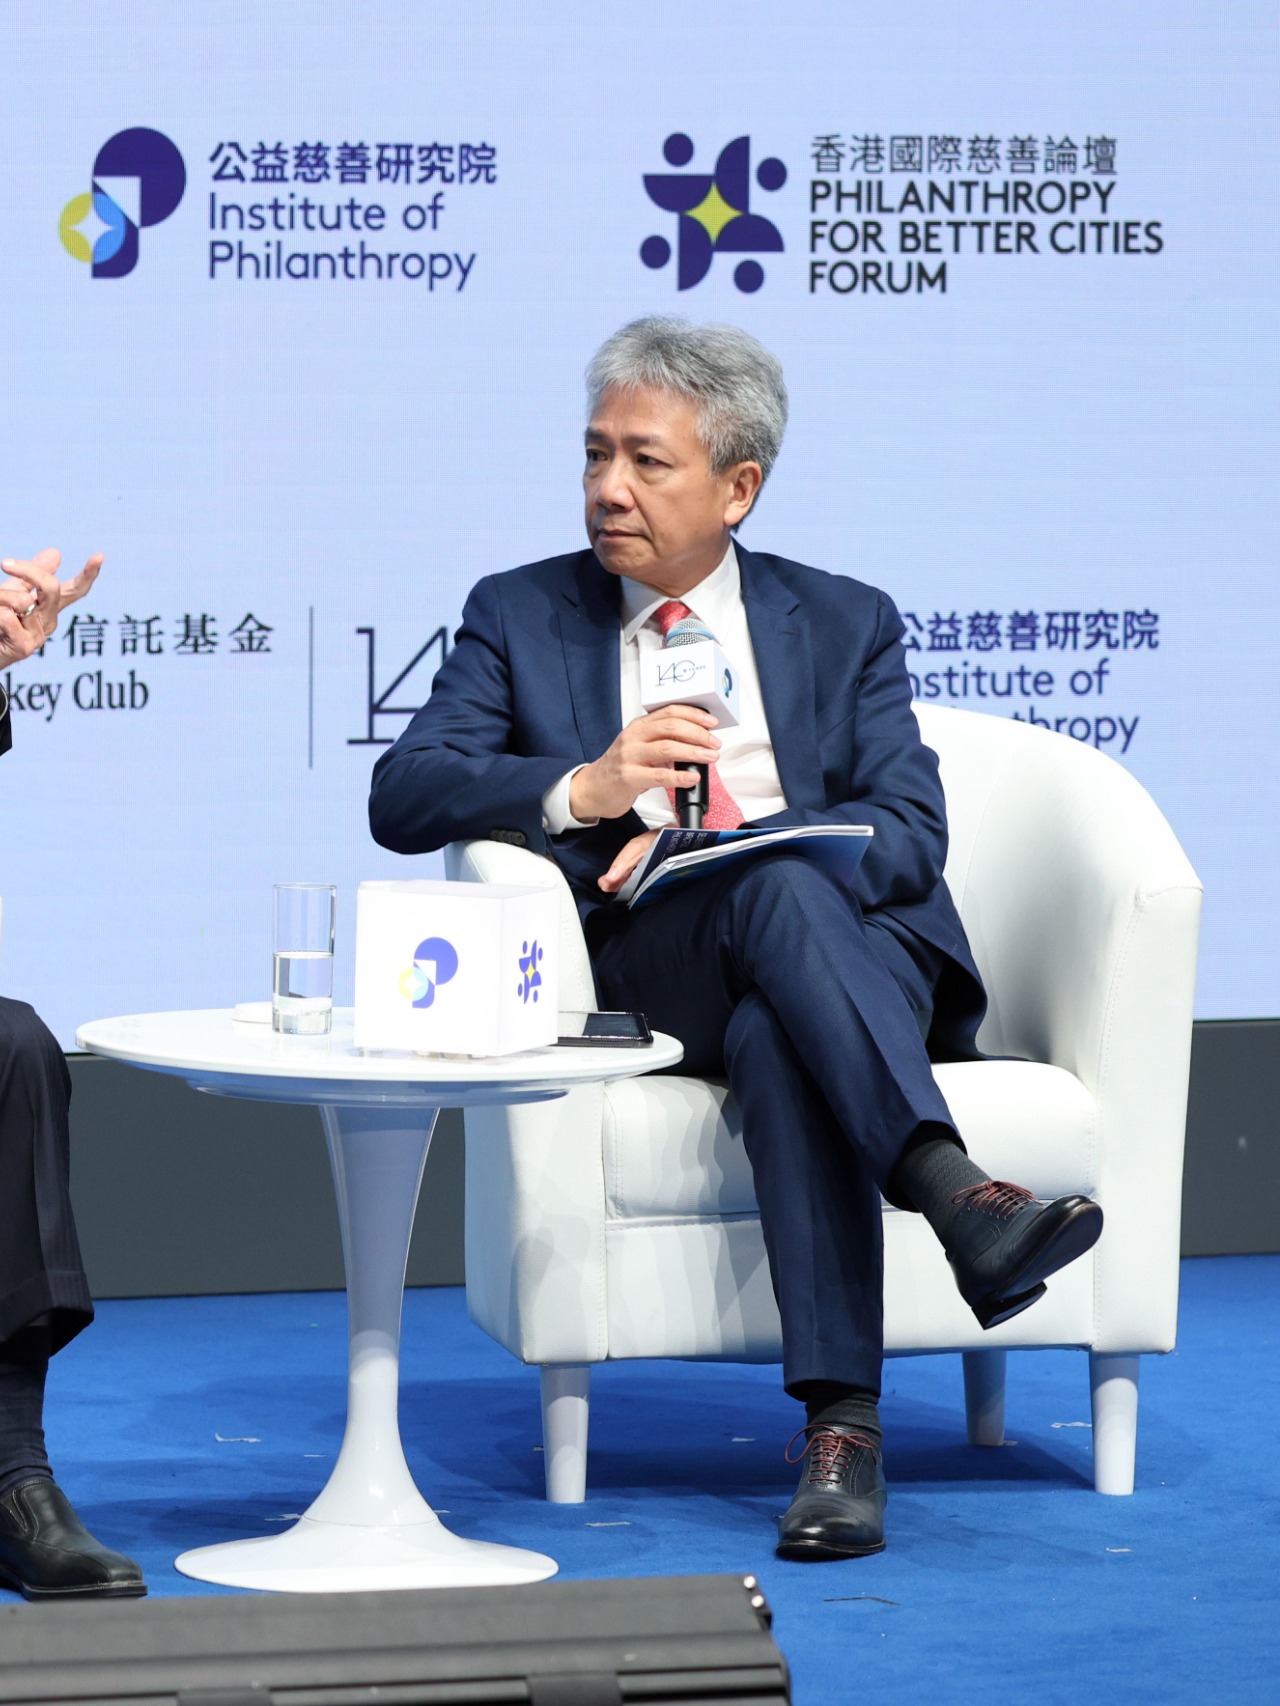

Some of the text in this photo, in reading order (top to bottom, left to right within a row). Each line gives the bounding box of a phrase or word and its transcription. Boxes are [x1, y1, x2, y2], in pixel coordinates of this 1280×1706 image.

[209, 141, 497, 185] 公益慈善研究院
[811, 134, 1118, 176] 香港國際慈善論壇
[209, 191, 446, 231] Institute of
[811, 179, 1117, 215] PHILANTHROPY
[810, 220, 1164, 254] FOR BETTER CITIES
[209, 240, 478, 292] Philanthropy
[810, 260, 948, 294] FORUM
[73, 669, 150, 711] Club
[909, 657, 1110, 698] nstitute of
